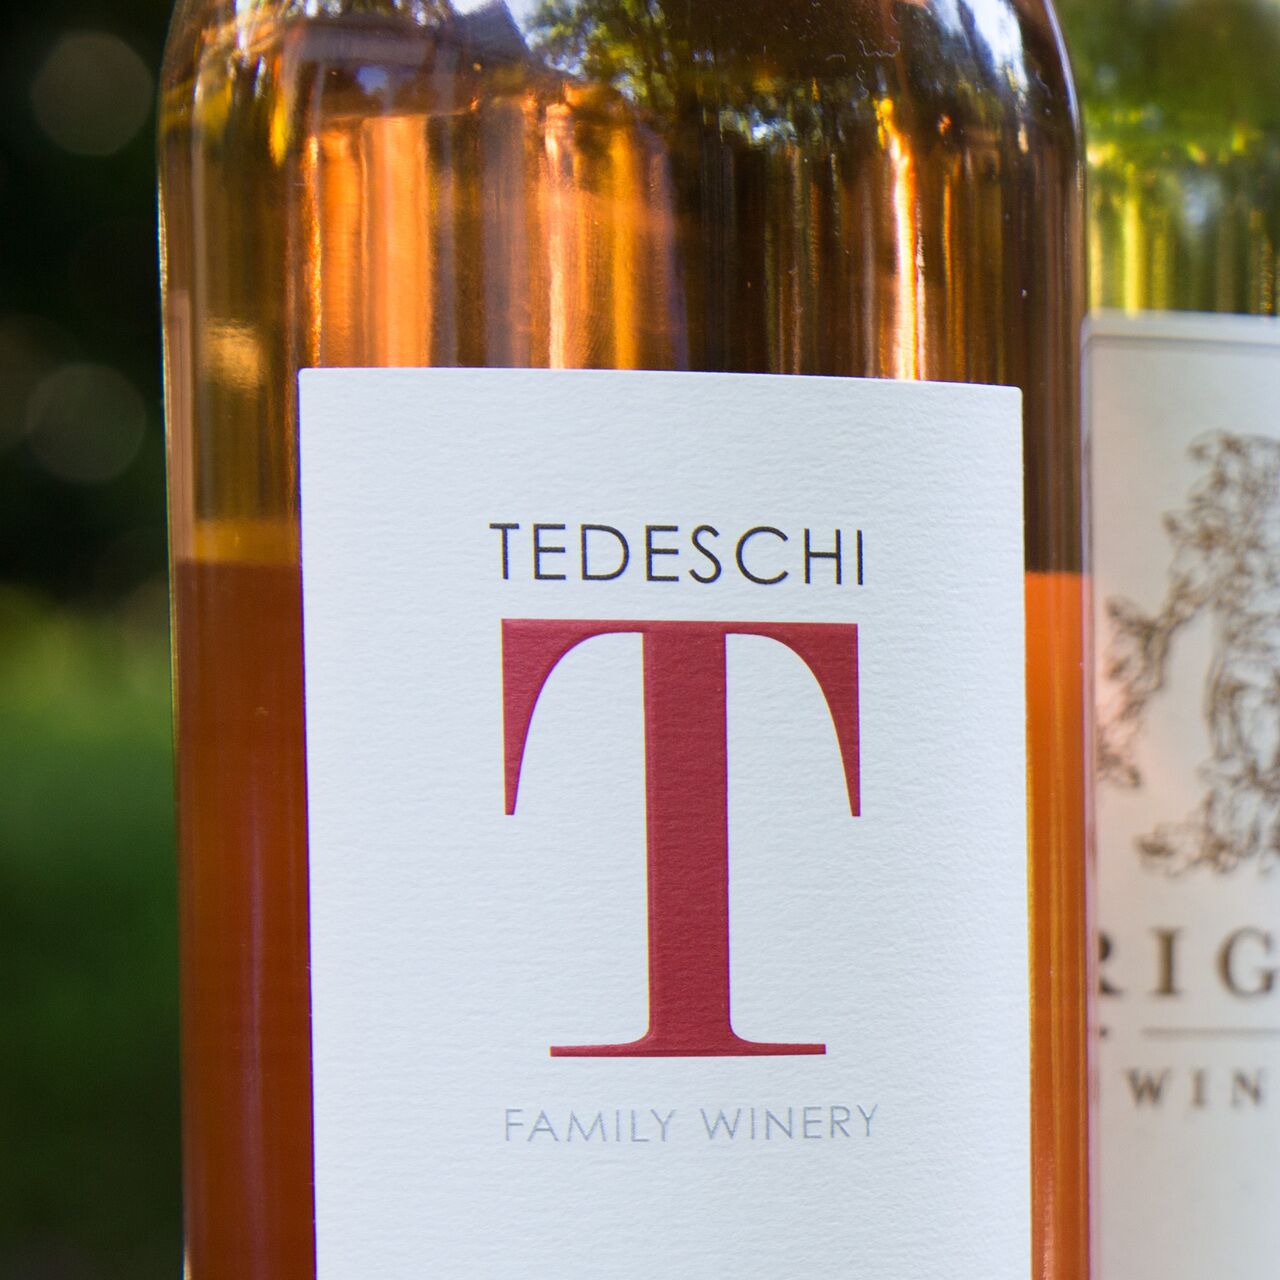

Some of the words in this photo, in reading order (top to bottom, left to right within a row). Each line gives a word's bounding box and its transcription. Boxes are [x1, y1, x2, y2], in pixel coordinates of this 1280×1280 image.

[489, 522, 865, 586] TEDESCHI
[501, 618, 862, 1059] T
[504, 1108, 676, 1143] FAMILY
[699, 1103, 879, 1141] WINERY
